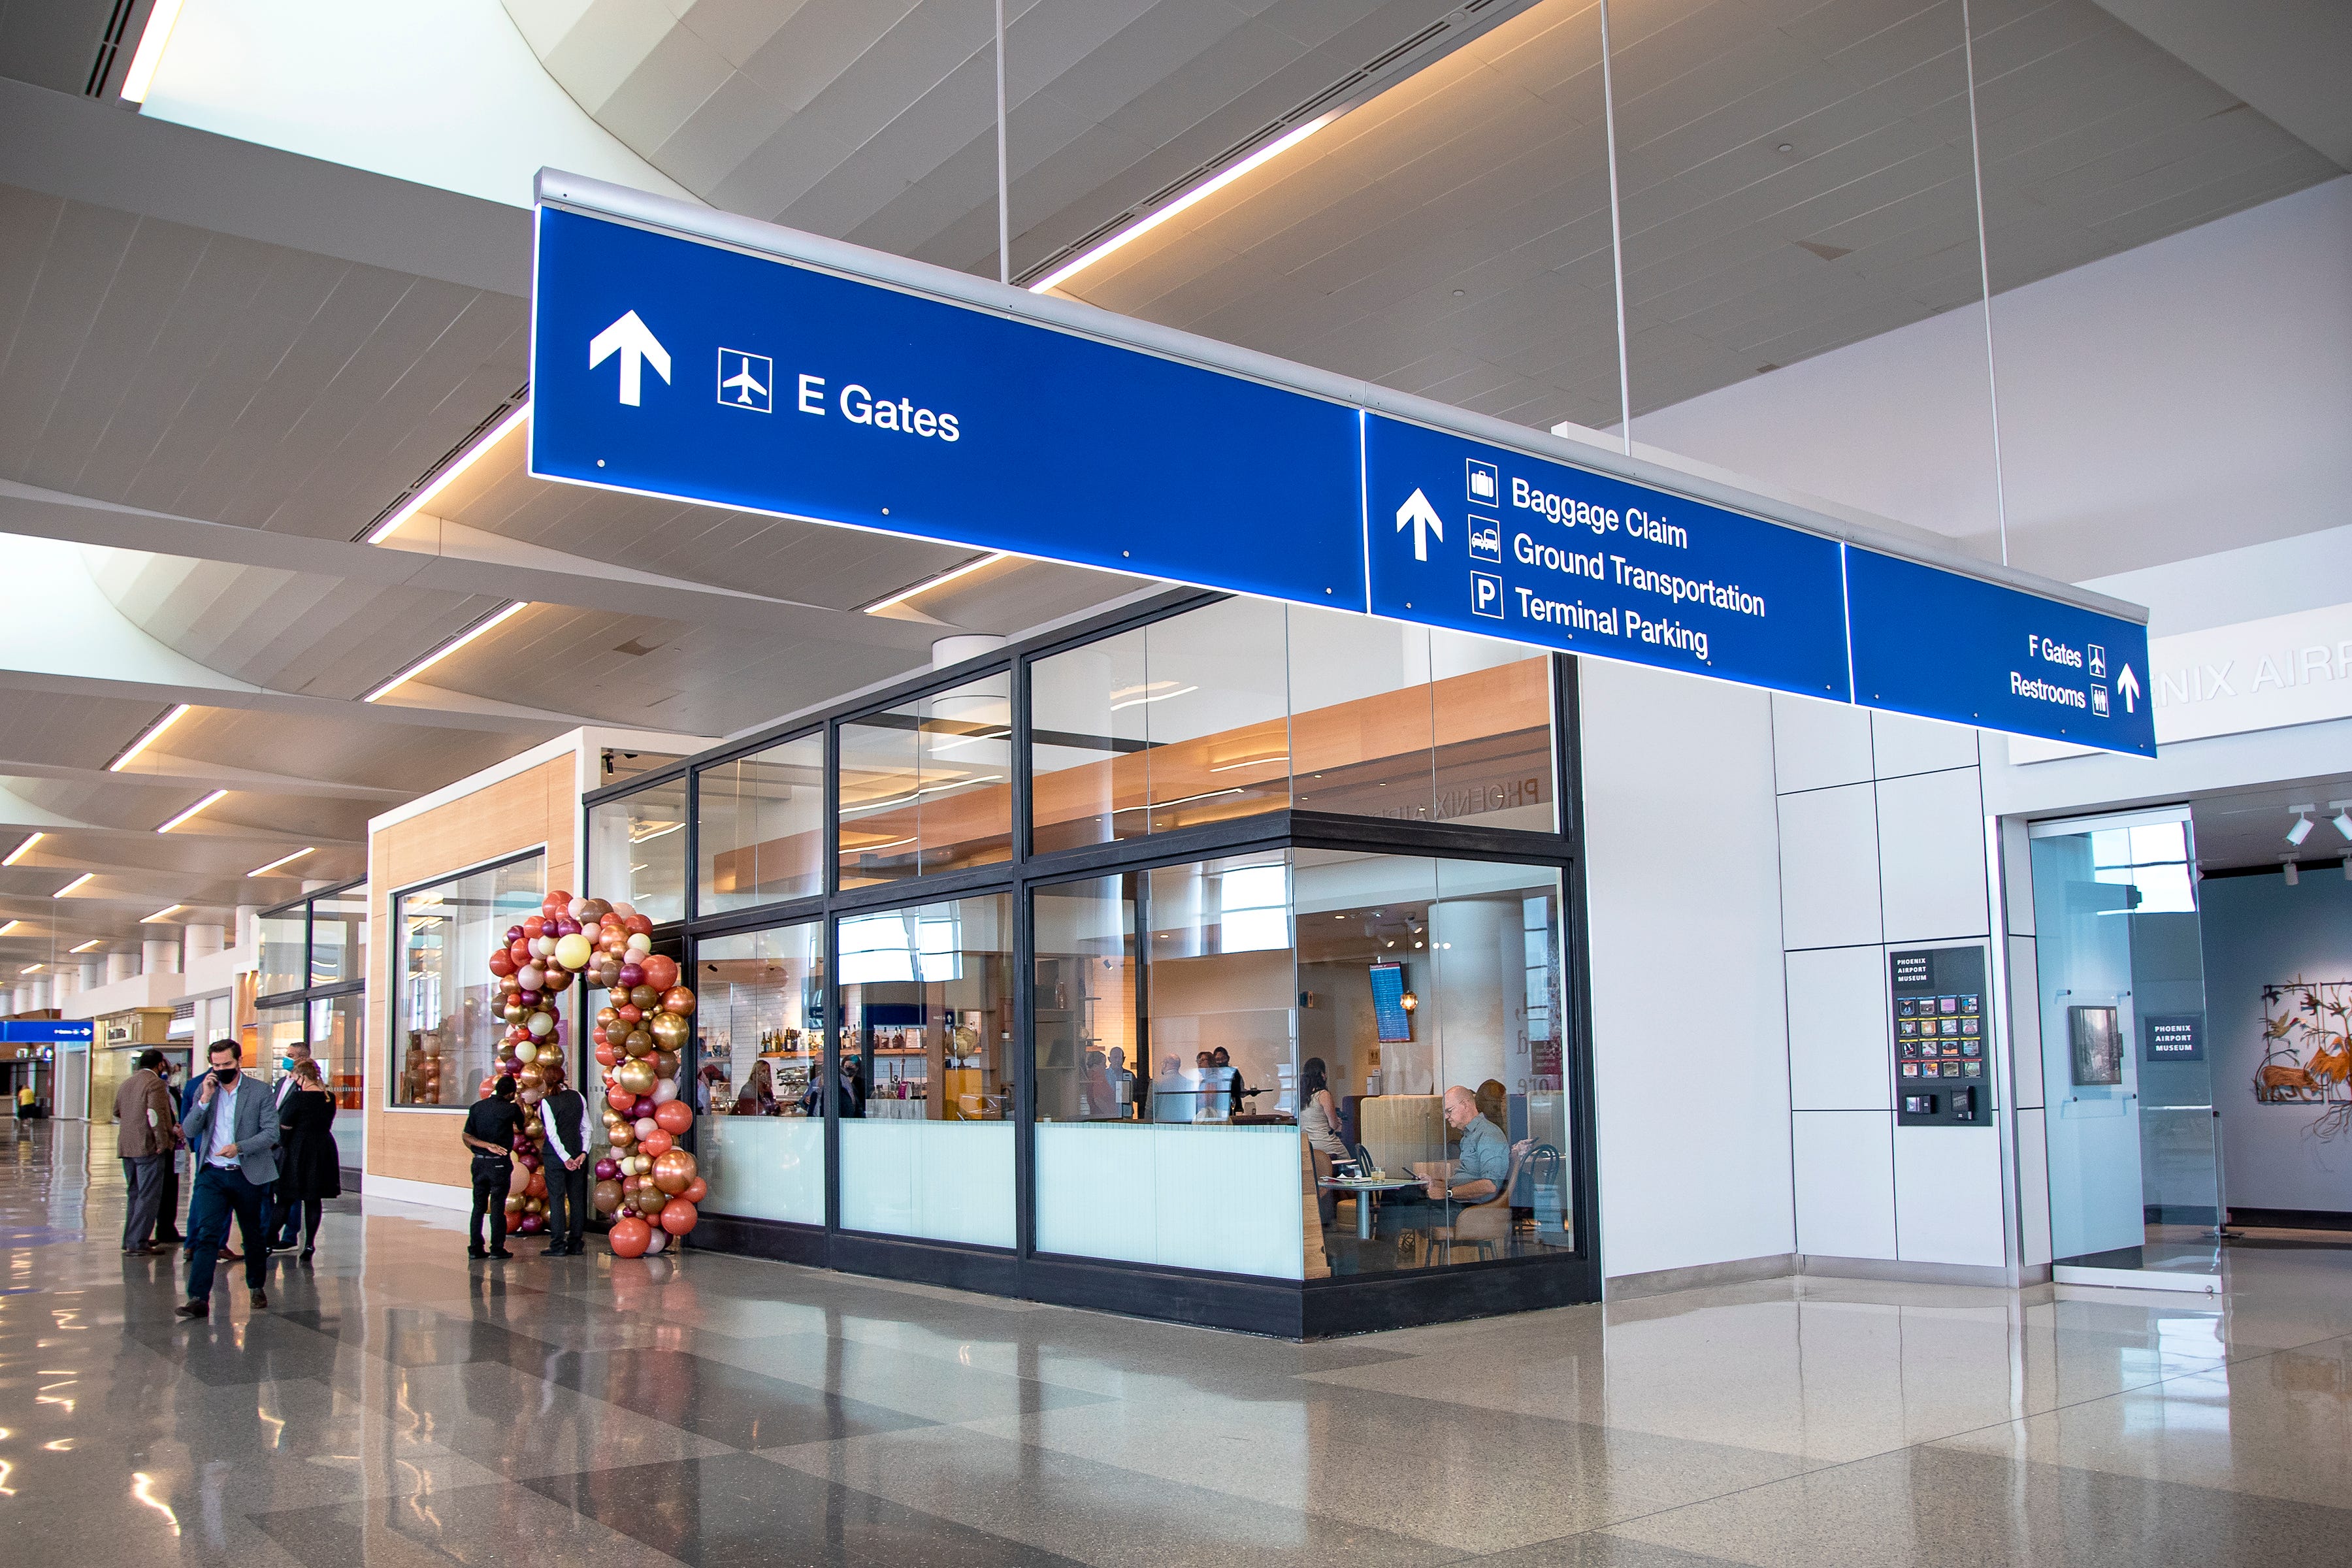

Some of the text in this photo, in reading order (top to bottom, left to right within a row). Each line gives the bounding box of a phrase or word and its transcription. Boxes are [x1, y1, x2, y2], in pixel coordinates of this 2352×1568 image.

[799, 374, 959, 441] E Gates
[1512, 478, 1687, 549] Baggage Claim
[1514, 532, 1765, 617] Ground Transportation
[1515, 587, 1708, 660] Terminal Parking
[2029, 635, 2082, 668] F Gates
[2011, 672, 2086, 709] Restrooms
